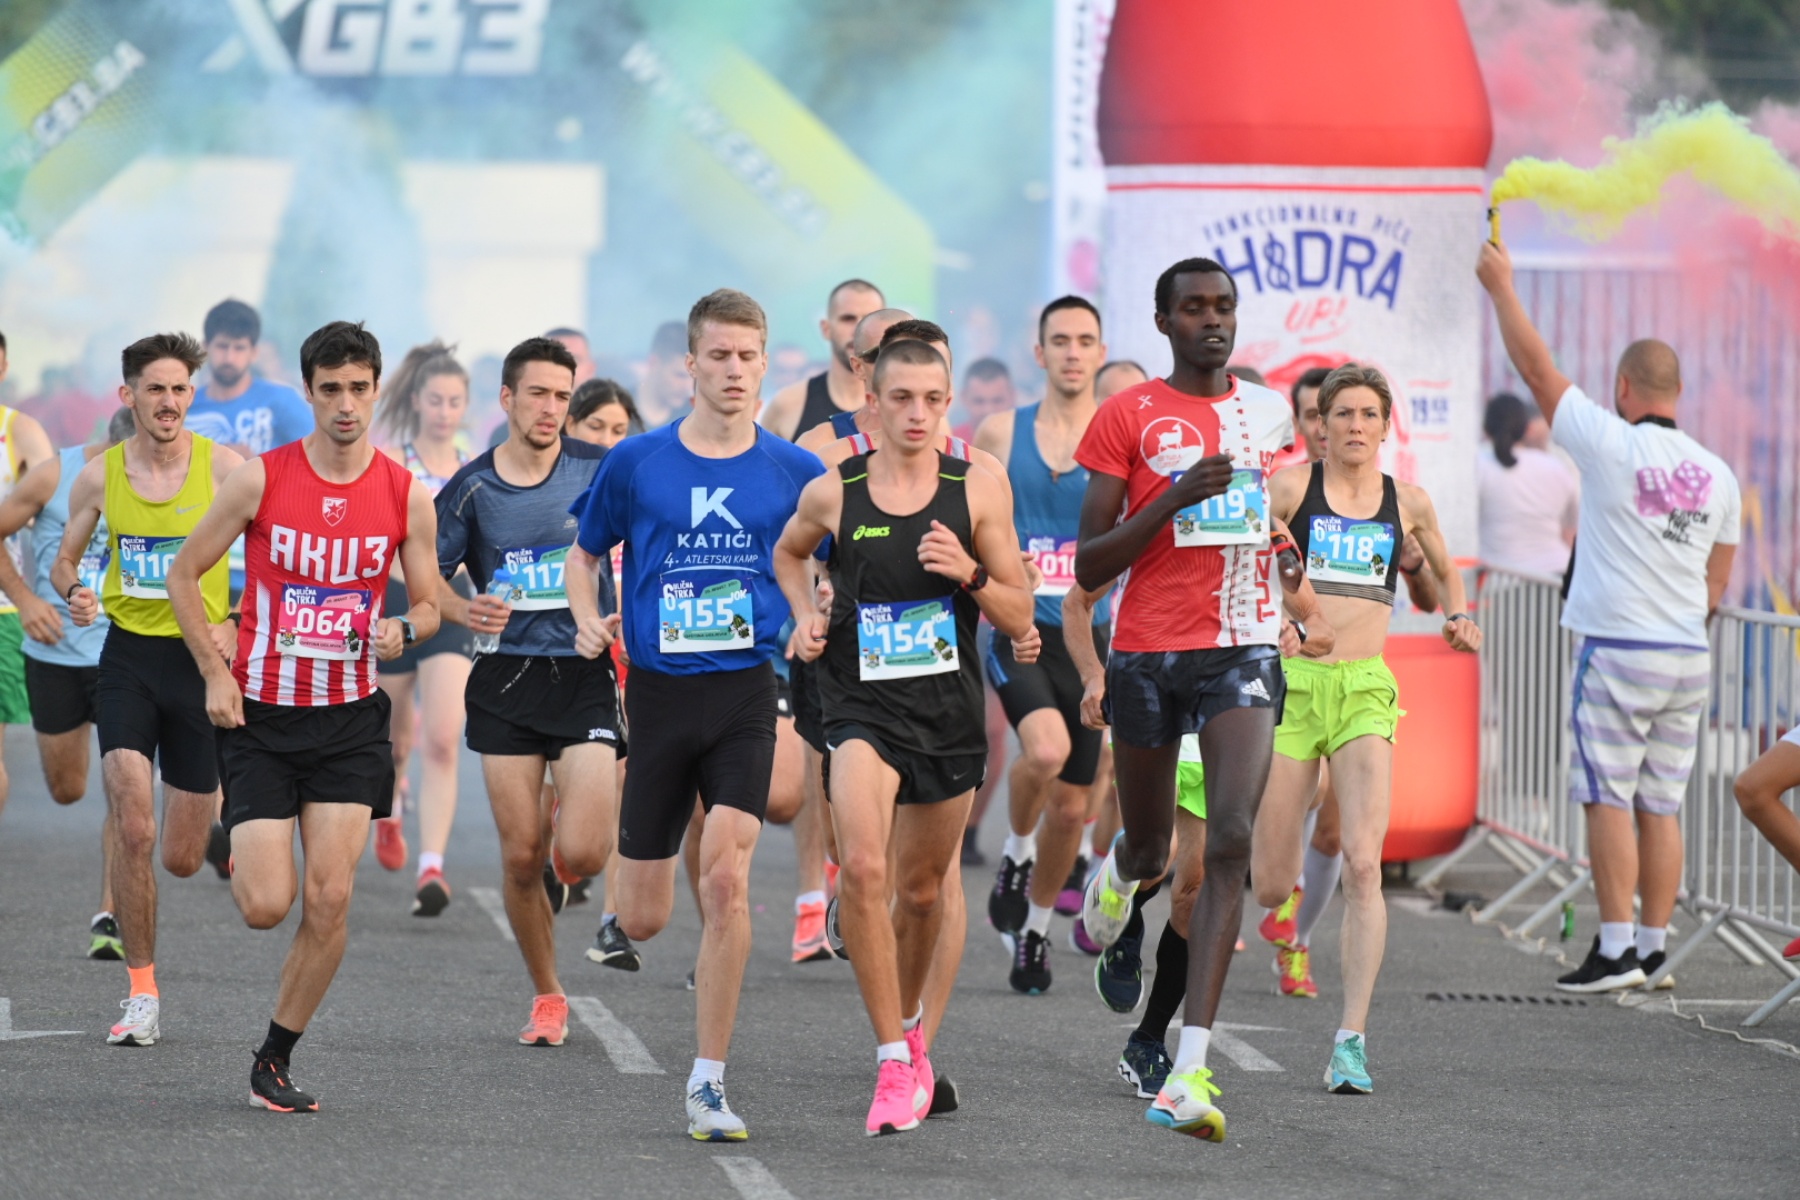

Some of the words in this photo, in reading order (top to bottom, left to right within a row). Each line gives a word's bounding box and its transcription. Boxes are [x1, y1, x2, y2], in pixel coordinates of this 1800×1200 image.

[677, 530, 752, 549] KATIĆI
[1328, 533, 1374, 563] 118
[683, 554, 732, 565] ATLETSKI
[733, 554, 759, 565] KAMP
[522, 562, 565, 590] 117
[297, 607, 352, 637] 064
[678, 597, 734, 628] 155
[875, 620, 939, 654] 154
